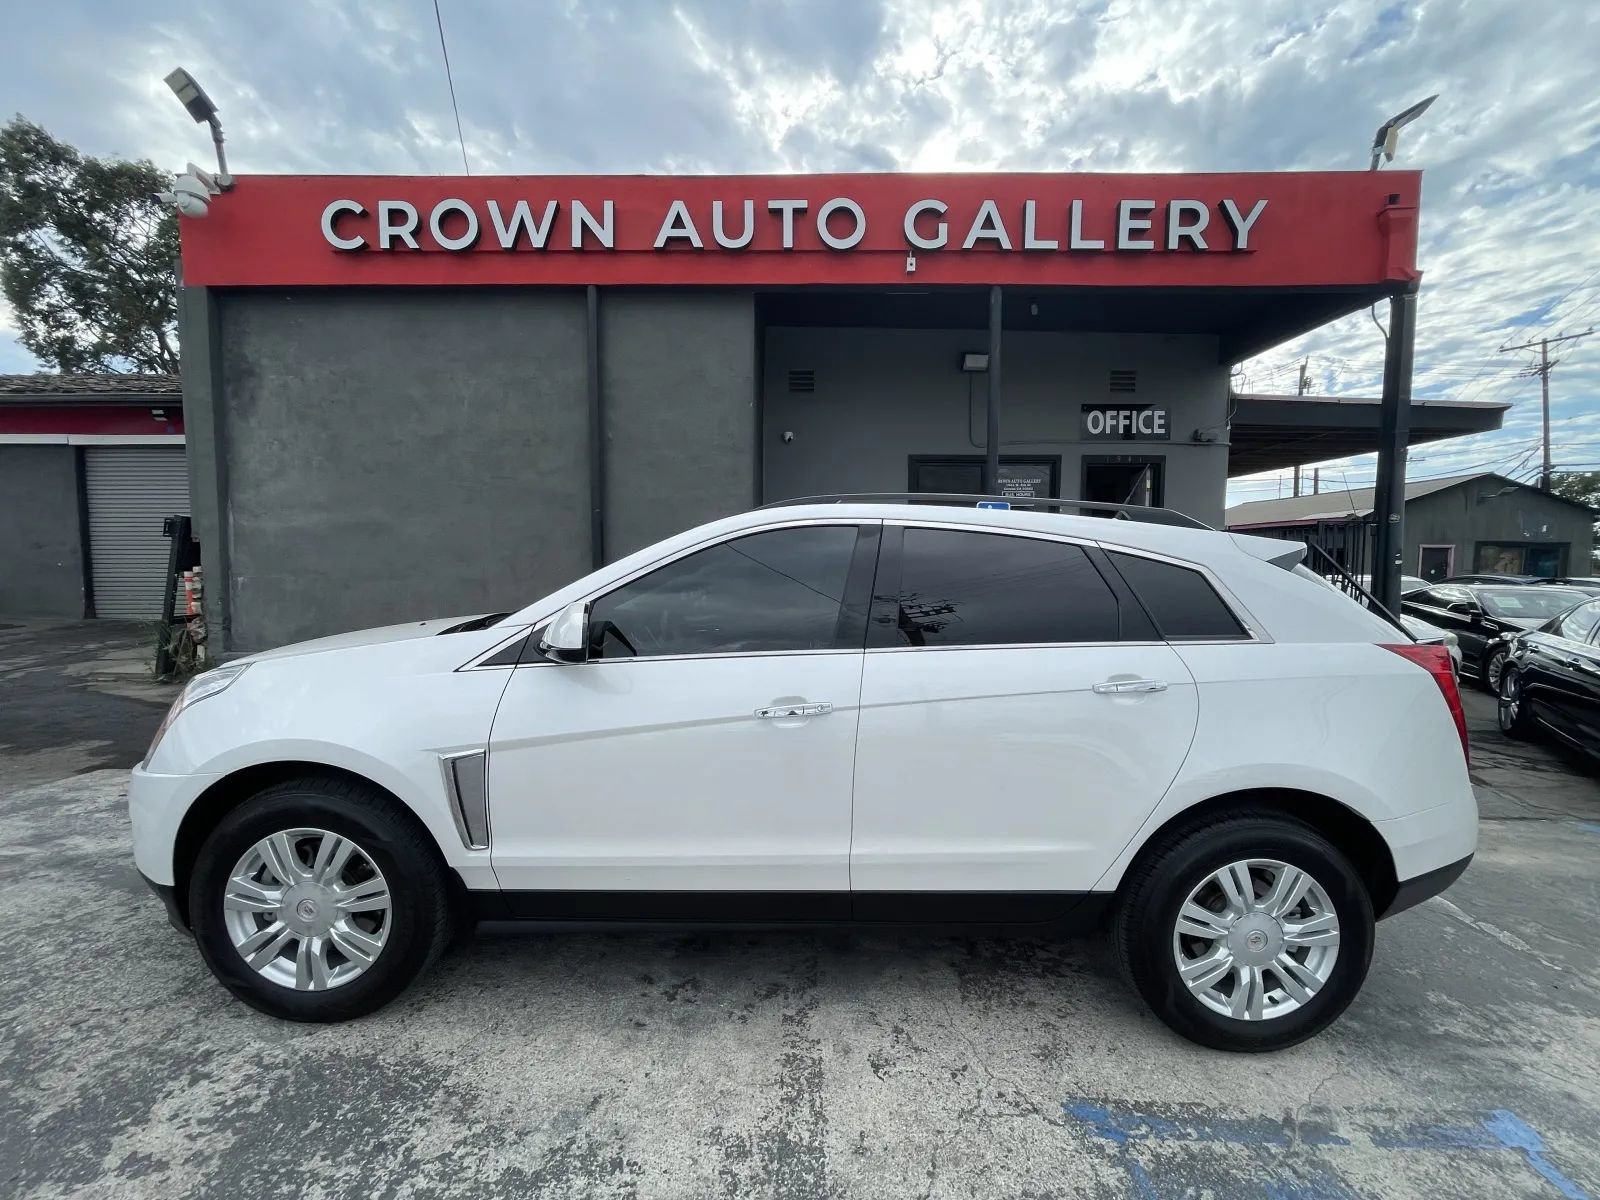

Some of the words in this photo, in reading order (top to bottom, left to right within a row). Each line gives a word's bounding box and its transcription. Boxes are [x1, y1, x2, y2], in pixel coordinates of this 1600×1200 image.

[320, 198, 616, 251] CROWN
[653, 197, 867, 251] AUTO
[903, 198, 1269, 251] GALLERY
[1087, 410, 1166, 435] OFFICE
